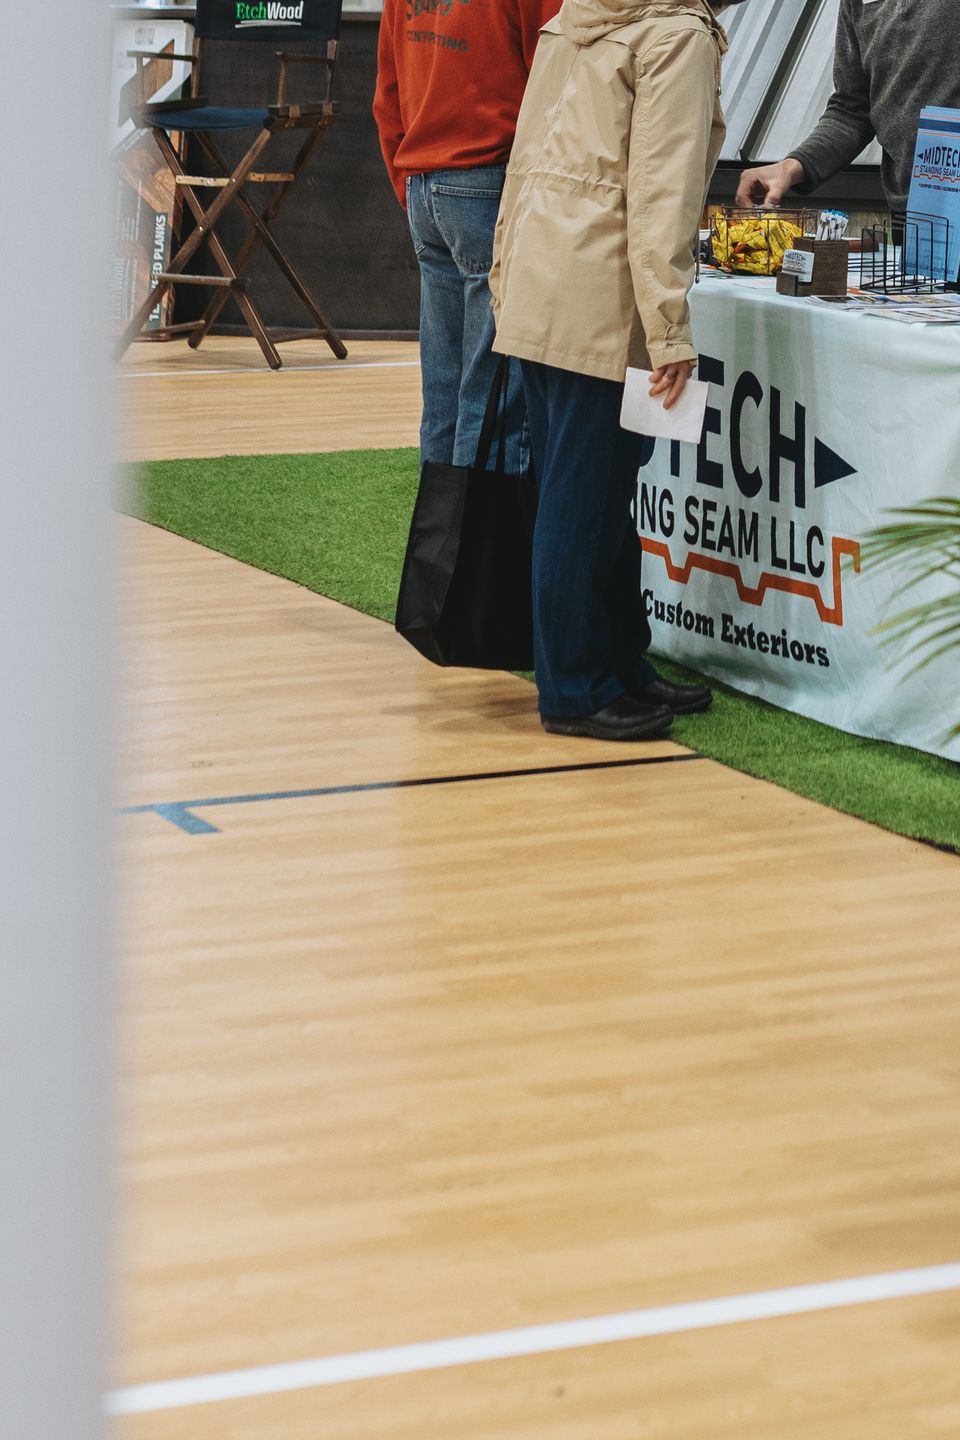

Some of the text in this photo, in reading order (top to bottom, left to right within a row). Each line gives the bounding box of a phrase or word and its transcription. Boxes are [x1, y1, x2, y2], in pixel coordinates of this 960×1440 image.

[235, 0, 304, 20] EtchWood
[920, 165, 942, 176] STANDING
[943, 167, 956, 178] SEAM
[153, 214, 166, 260] PLANKS
[683, 495, 759, 562] SEAM
[771, 516, 825, 578] LLC
[642, 588, 831, 668] Custom Exteriors
